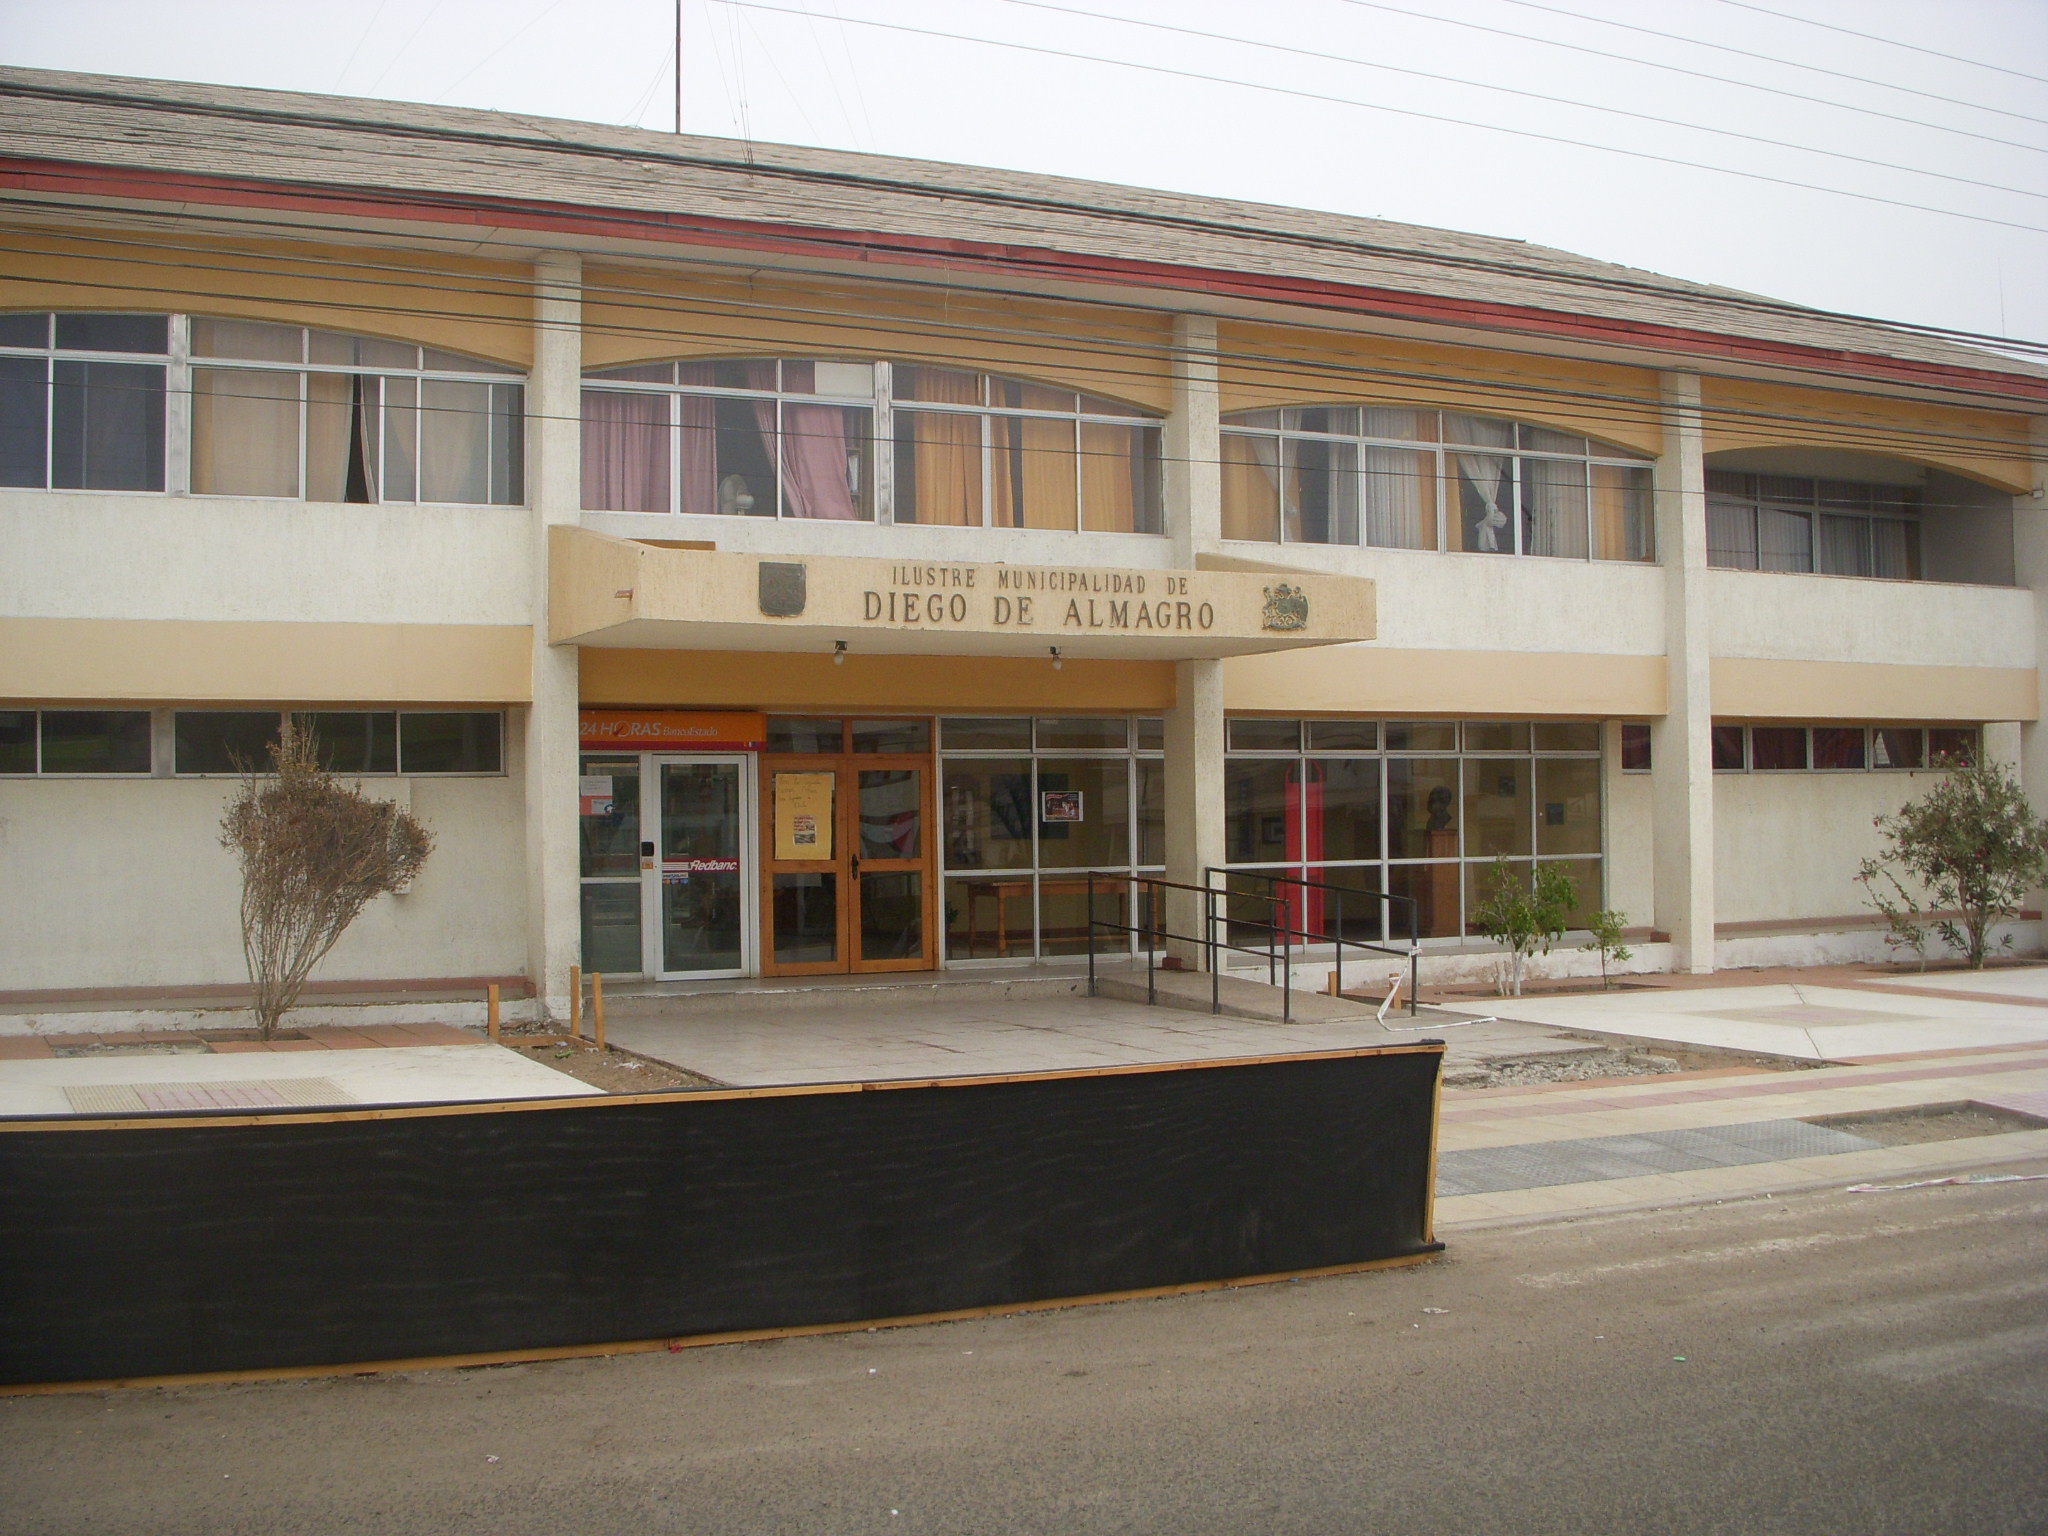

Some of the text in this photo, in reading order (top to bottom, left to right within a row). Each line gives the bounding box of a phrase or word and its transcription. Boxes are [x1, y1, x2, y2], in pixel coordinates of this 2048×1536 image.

[892, 566, 1188, 596] ILUSTRE MUNICIPALIDAD DE
[863, 590, 1214, 630] DIEGO DE ALMAGRO
[580, 720, 718, 737] 24 HORAS BancoEstado
[689, 860, 737, 871] Redbanc
